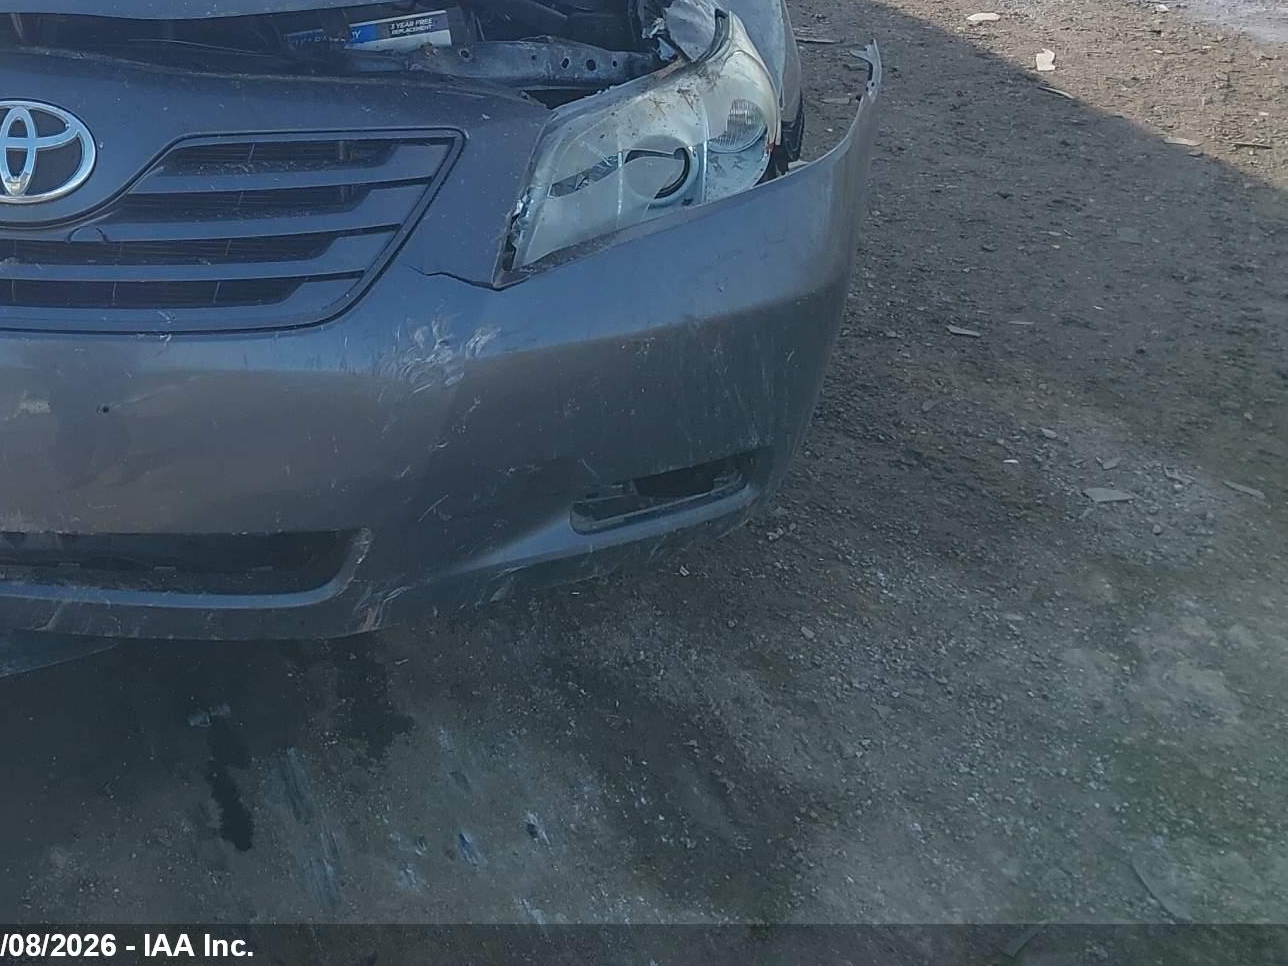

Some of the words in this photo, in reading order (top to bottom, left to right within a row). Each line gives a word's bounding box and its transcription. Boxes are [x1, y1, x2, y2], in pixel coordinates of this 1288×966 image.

[395, 21, 414, 29] YEAR
[415, 18, 433, 27] FREE
[391, 25, 433, 35] REPLACEMENT
